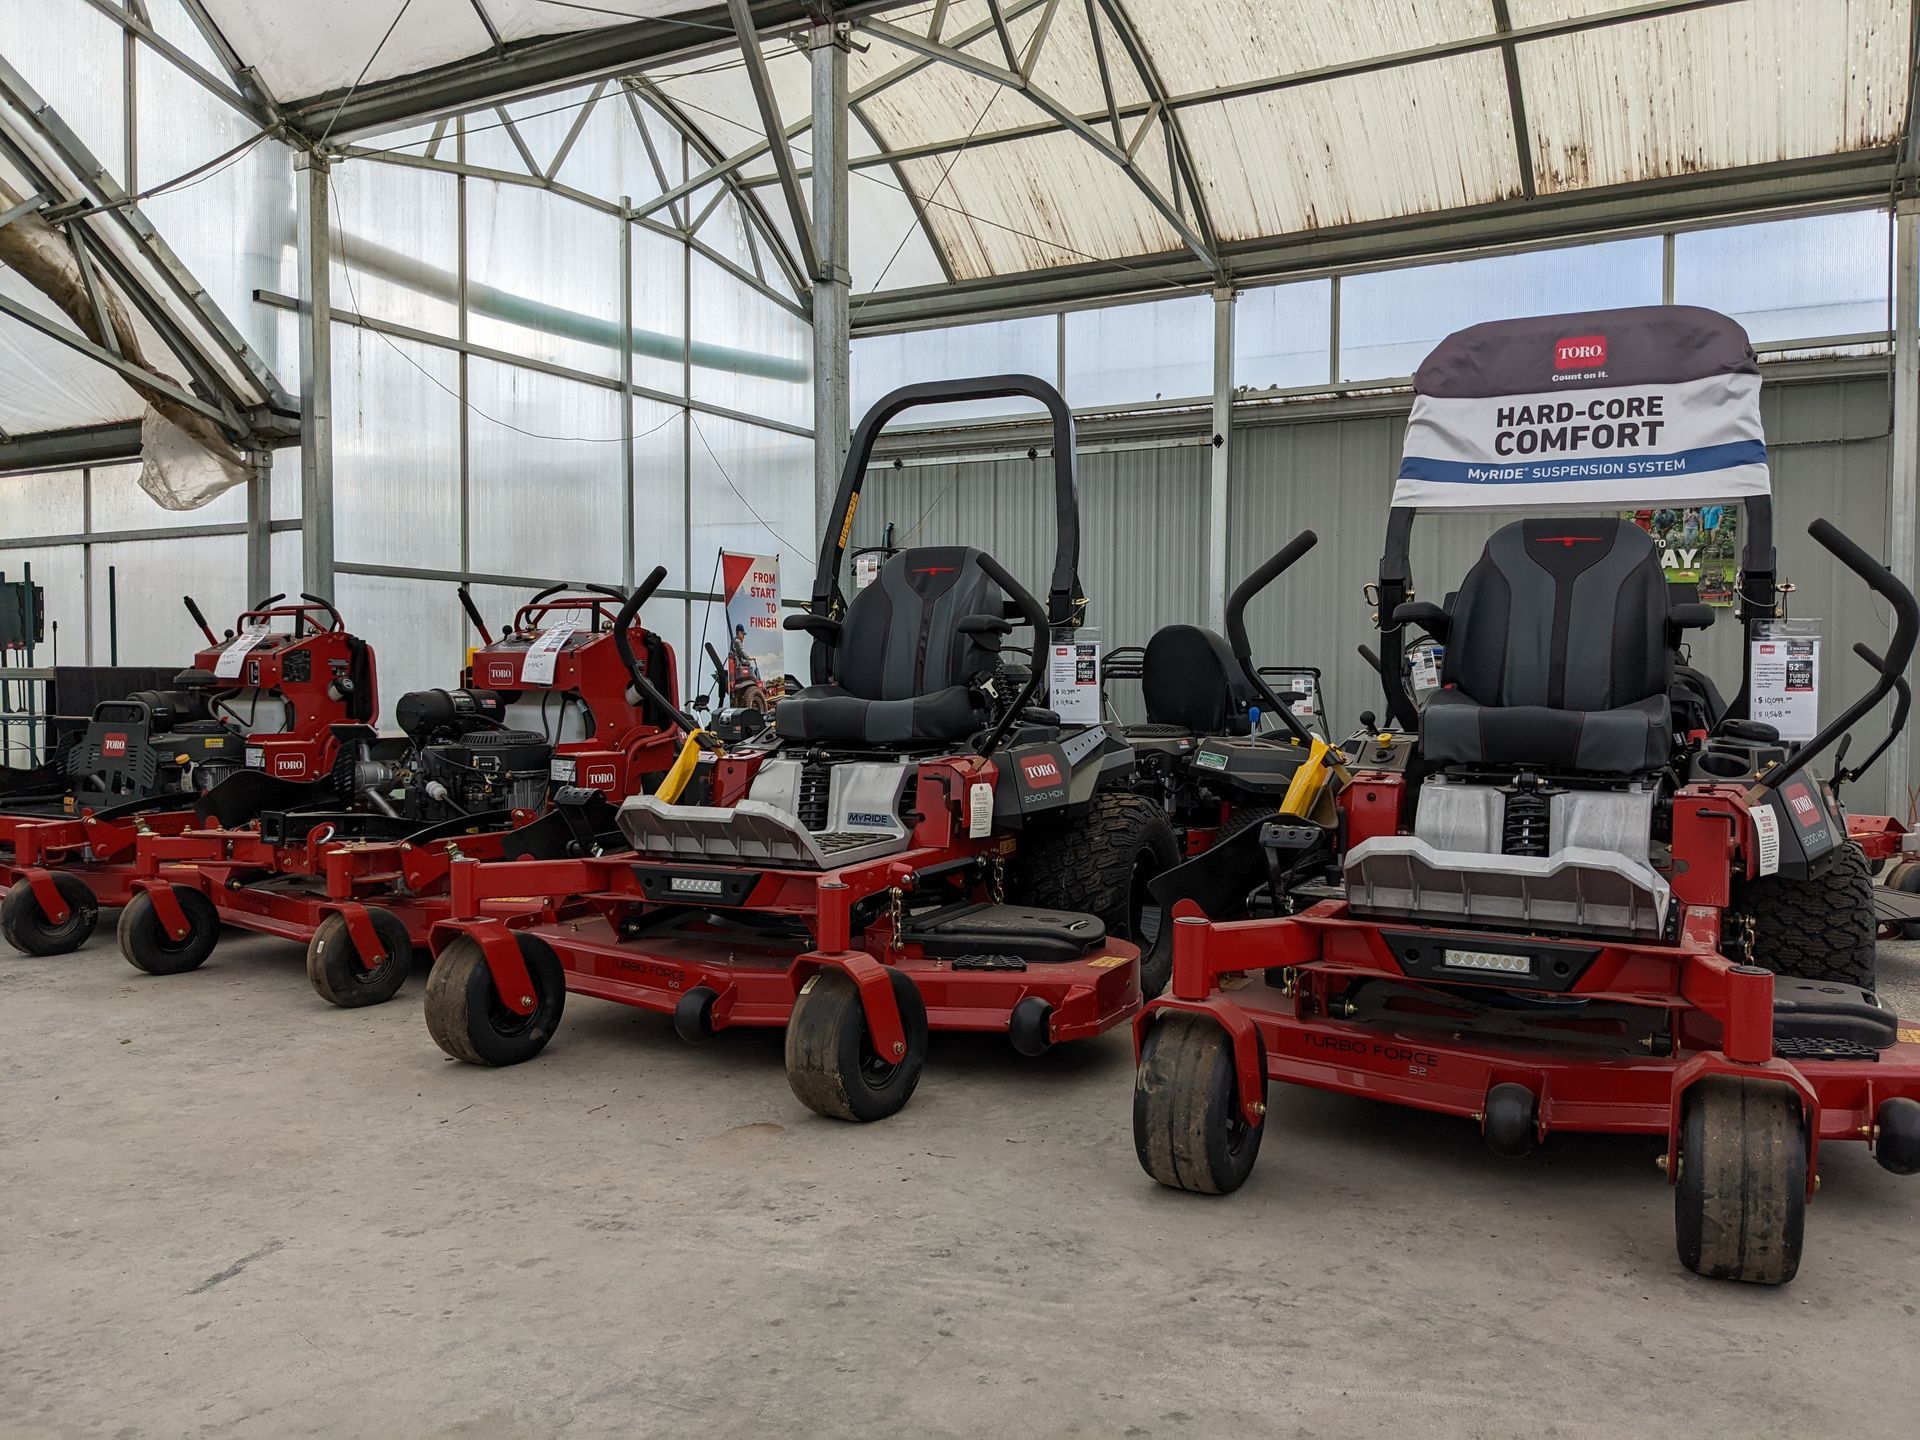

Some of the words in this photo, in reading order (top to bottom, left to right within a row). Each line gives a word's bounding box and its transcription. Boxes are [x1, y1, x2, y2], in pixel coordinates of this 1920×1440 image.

[1558, 345, 1603, 360] TORO
[1552, 373, 1582, 382] Count
[1598, 371, 1608, 379] it.
[1496, 396, 1664, 428] HARD-CORE
[1495, 421, 1665, 456] COMFORT
[1532, 462, 1625, 478] SUSPENSION
[1628, 458, 1686, 473] SYSTEM
[753, 572, 776, 584] FROM
[750, 587, 776, 599] START
[766, 603, 777, 613] TO
[750, 617, 777, 628] FINISH
[490, 669, 511, 678] TORO
[105, 740, 125, 750] TORO
[277, 761, 303, 770] TORO
[1025, 763, 1056, 779] TORO
[589, 773, 614, 784] TORO
[1024, 793, 1048, 804] 2000
[1048, 789, 1065, 798] HDX
[1791, 794, 1813, 814] TORO
[848, 813, 888, 824] MyRIDE
[1802, 832, 1819, 847] 2000
[612, 959, 646, 974] TURBO
[649, 965, 686, 981] FORCE
[668, 981, 680, 989] 60
[1303, 1032, 1367, 1054] TURBO
[1372, 1044, 1439, 1067] FORCE
